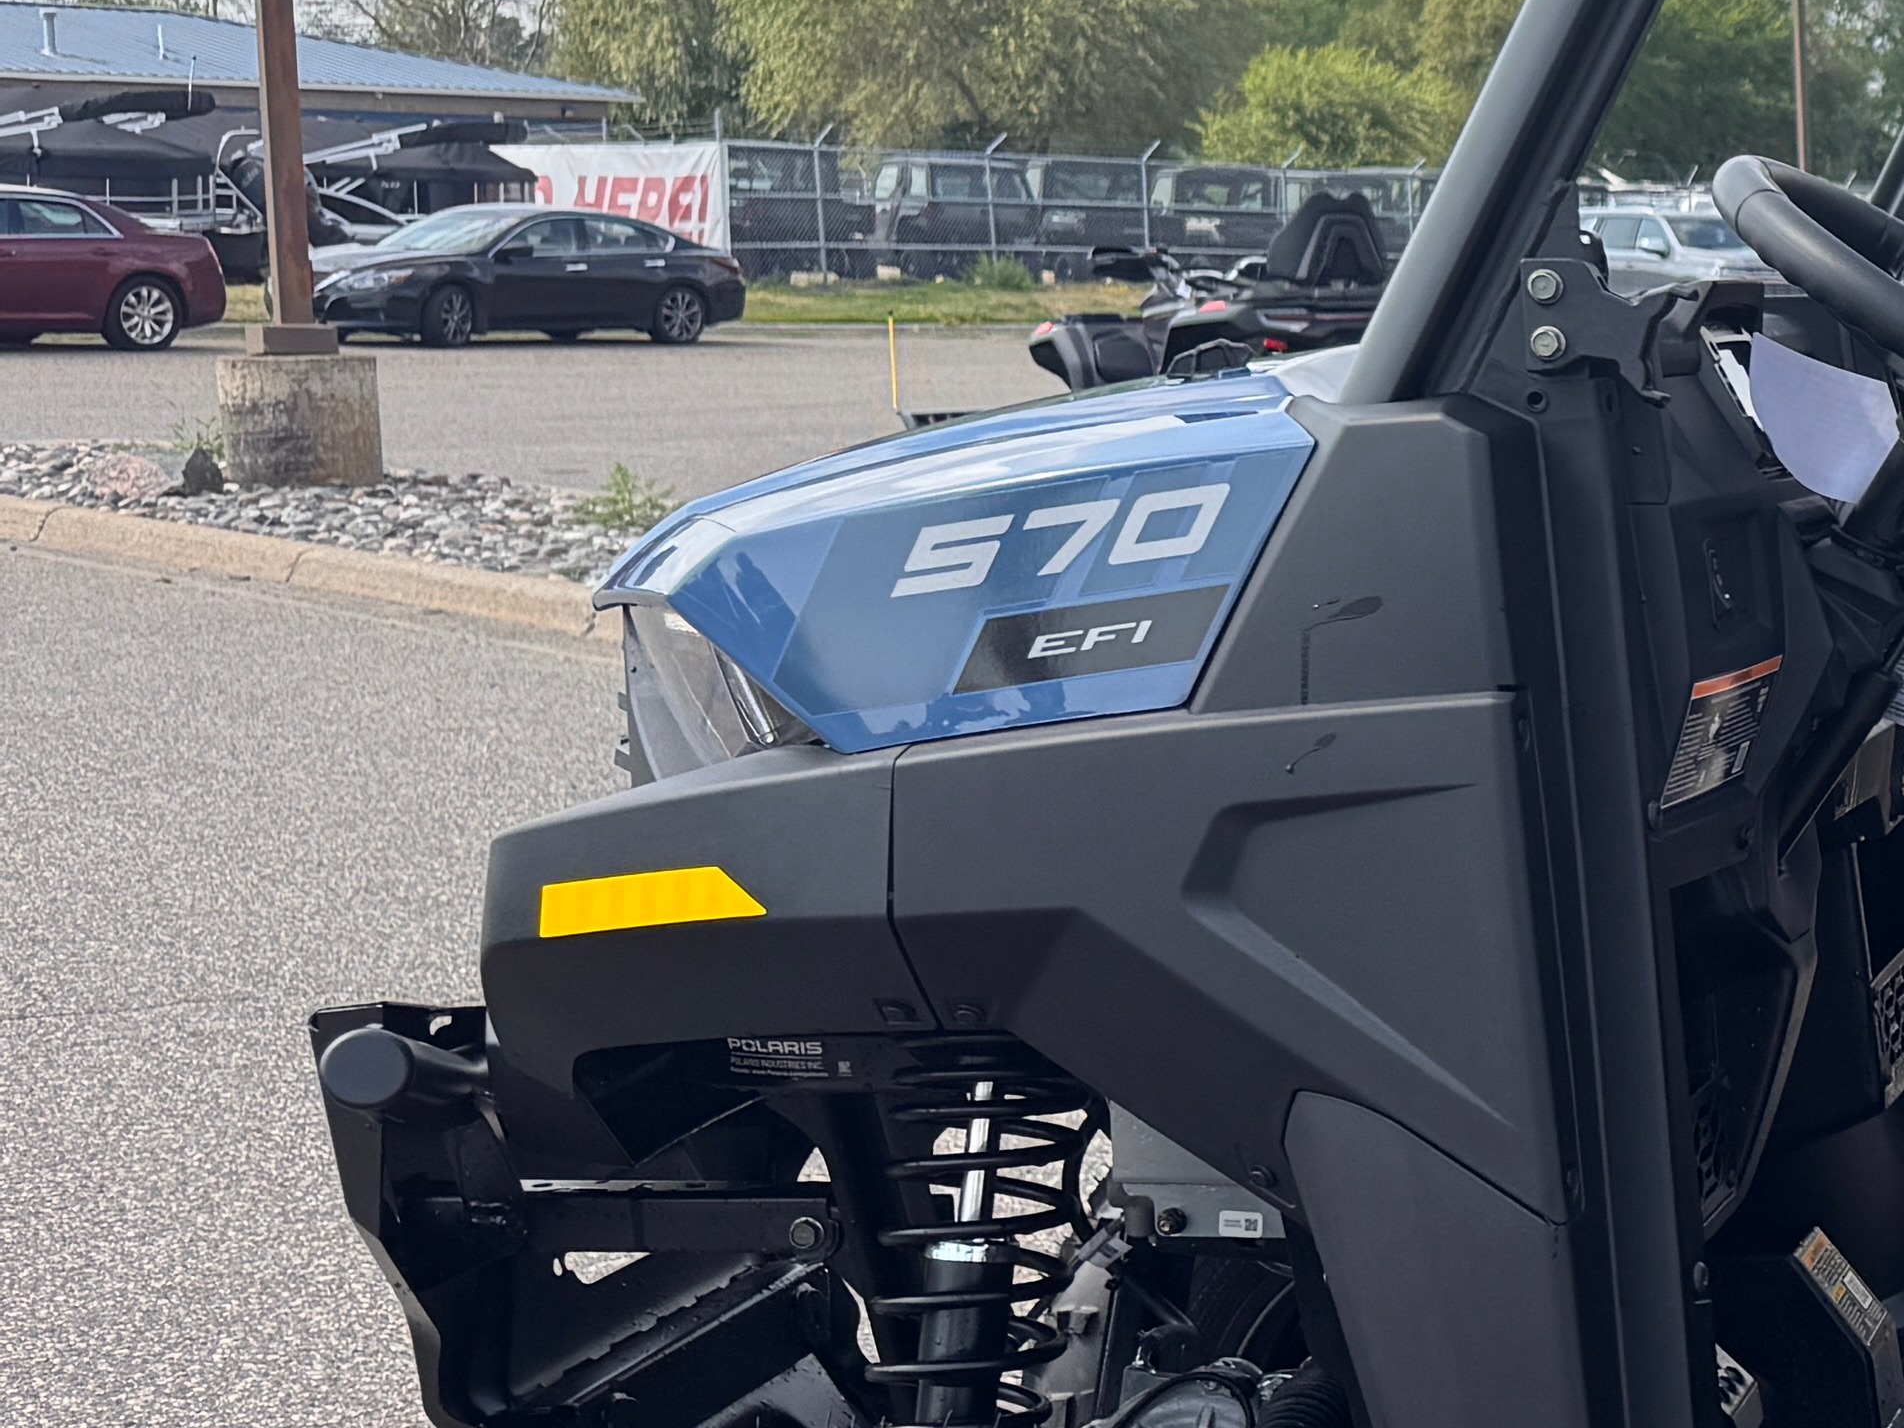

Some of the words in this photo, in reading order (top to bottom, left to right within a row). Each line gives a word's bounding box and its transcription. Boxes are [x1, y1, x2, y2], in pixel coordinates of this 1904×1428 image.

[891, 483, 1230, 597] 570
[1027, 619, 1153, 660] EFI
[727, 1038, 823, 1054] POLARIS
